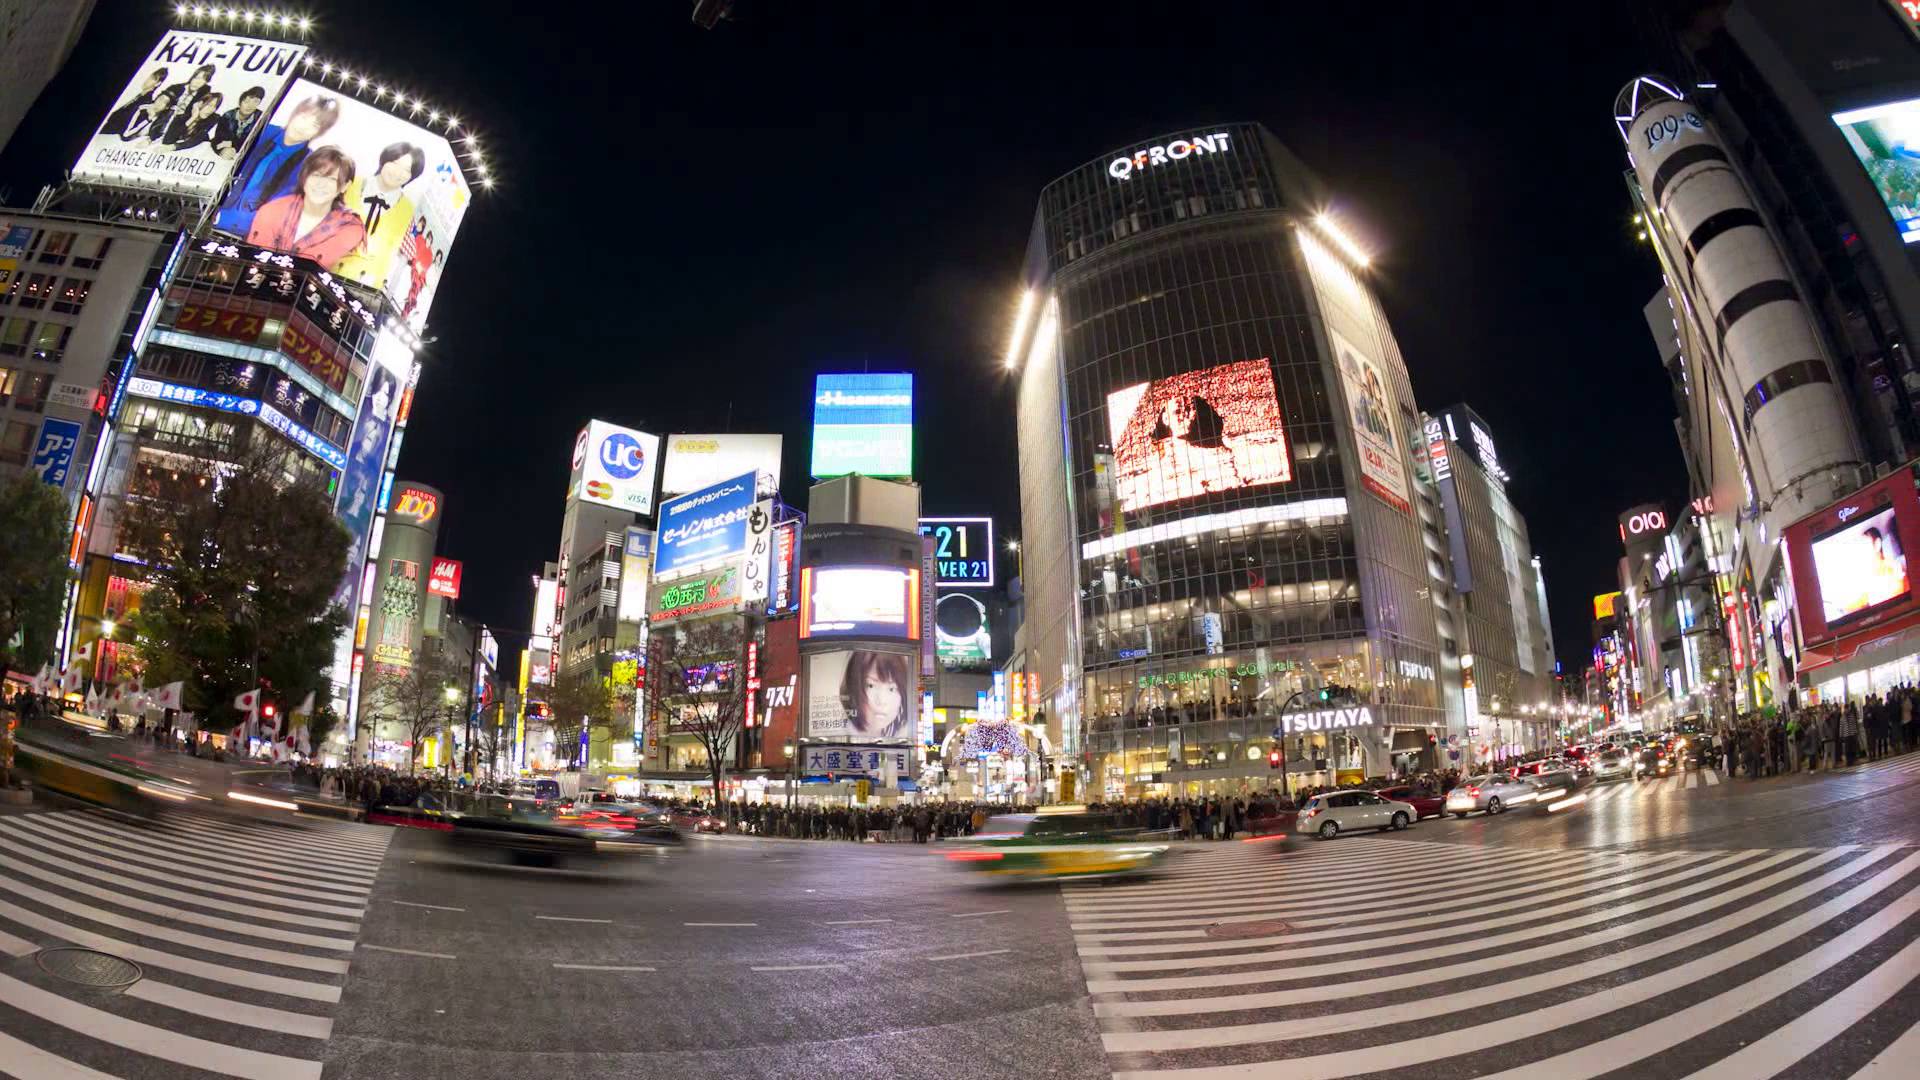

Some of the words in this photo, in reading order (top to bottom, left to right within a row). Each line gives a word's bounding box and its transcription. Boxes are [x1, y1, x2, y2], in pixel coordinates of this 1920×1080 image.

[155, 35, 298, 76] KAT-TUN
[96, 148, 144, 168] CHANGE
[144, 154, 161, 170] UR
[166, 155, 216, 176] WORLD
[1109, 132, 1229, 180] QFRONT
[283, 328, 344, 383] コンタクト
[603, 440, 643, 471] UC
[1425, 422, 1452, 480] SEIBU
[395, 494, 437, 522] 109
[628, 494, 647, 505] VISA
[745, 506, 768, 594] もんじゃ
[971, 561, 987, 577] 21
[1138, 667, 1228, 688] STARBUCKS
[1236, 659, 1296, 678] COFEE
[1282, 707, 1373, 733] TSUTAYA
